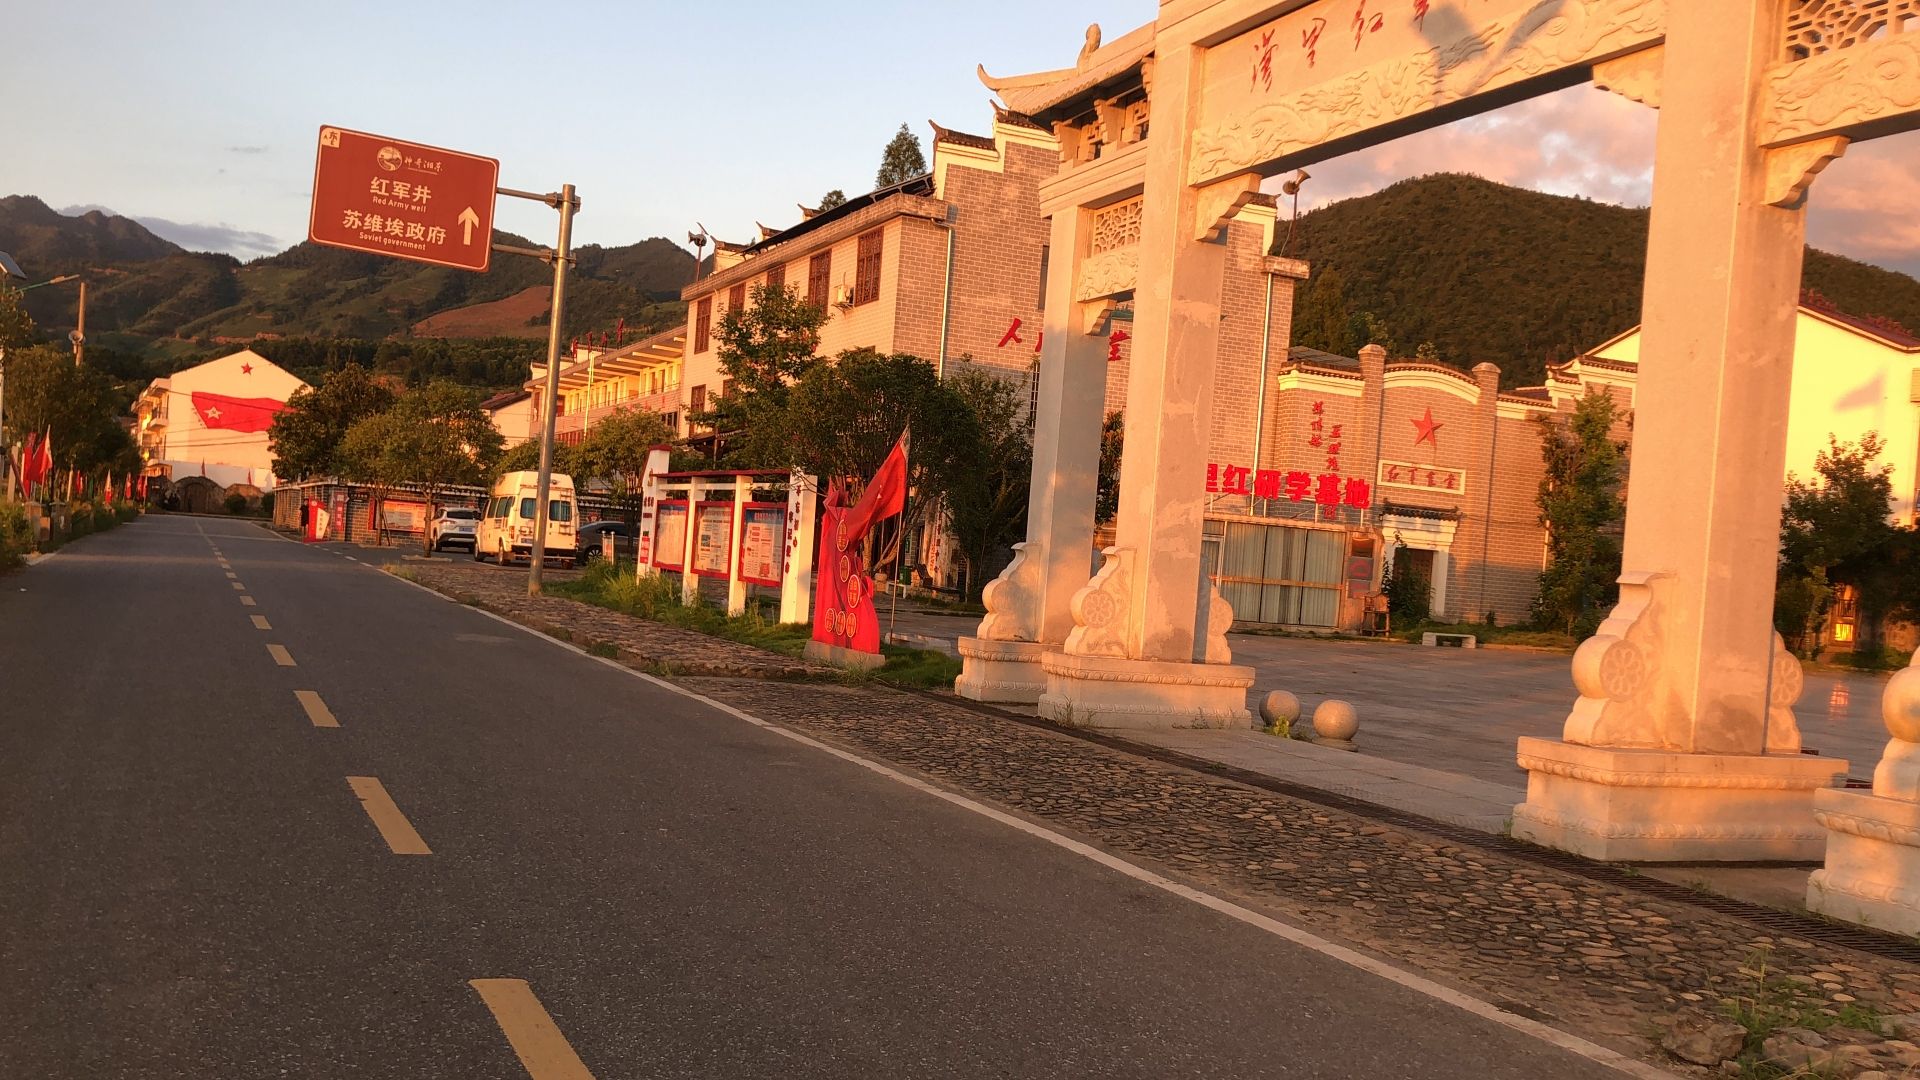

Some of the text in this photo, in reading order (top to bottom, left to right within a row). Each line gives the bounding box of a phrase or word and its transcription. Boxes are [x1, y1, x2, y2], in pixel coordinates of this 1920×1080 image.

[370, 176, 432, 205] 红军井
[372, 196, 427, 213] Red Army well
[342, 209, 446, 245] 苏维埃政府
[359, 231, 426, 251] Soviet government
